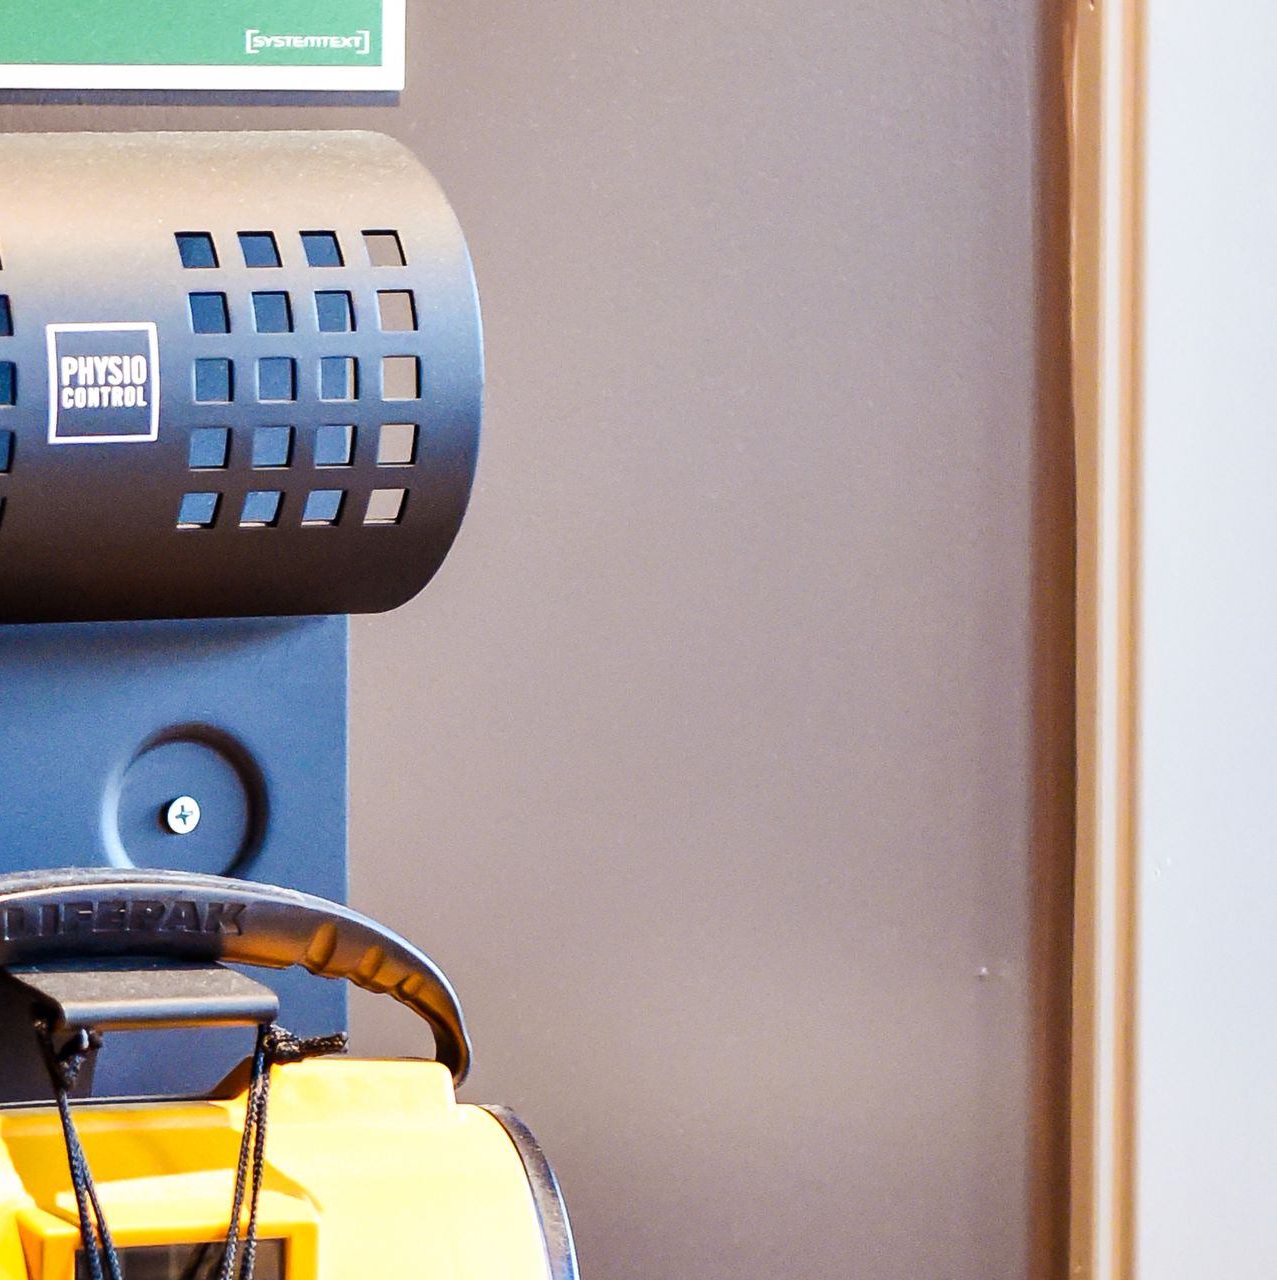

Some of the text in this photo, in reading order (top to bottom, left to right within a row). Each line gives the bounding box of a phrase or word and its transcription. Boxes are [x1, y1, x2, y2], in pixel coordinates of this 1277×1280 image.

[61, 354, 147, 386] PHYSIO
[61, 385, 148, 409] CONTROL
[3, 900, 247, 940] LIFEPAK
